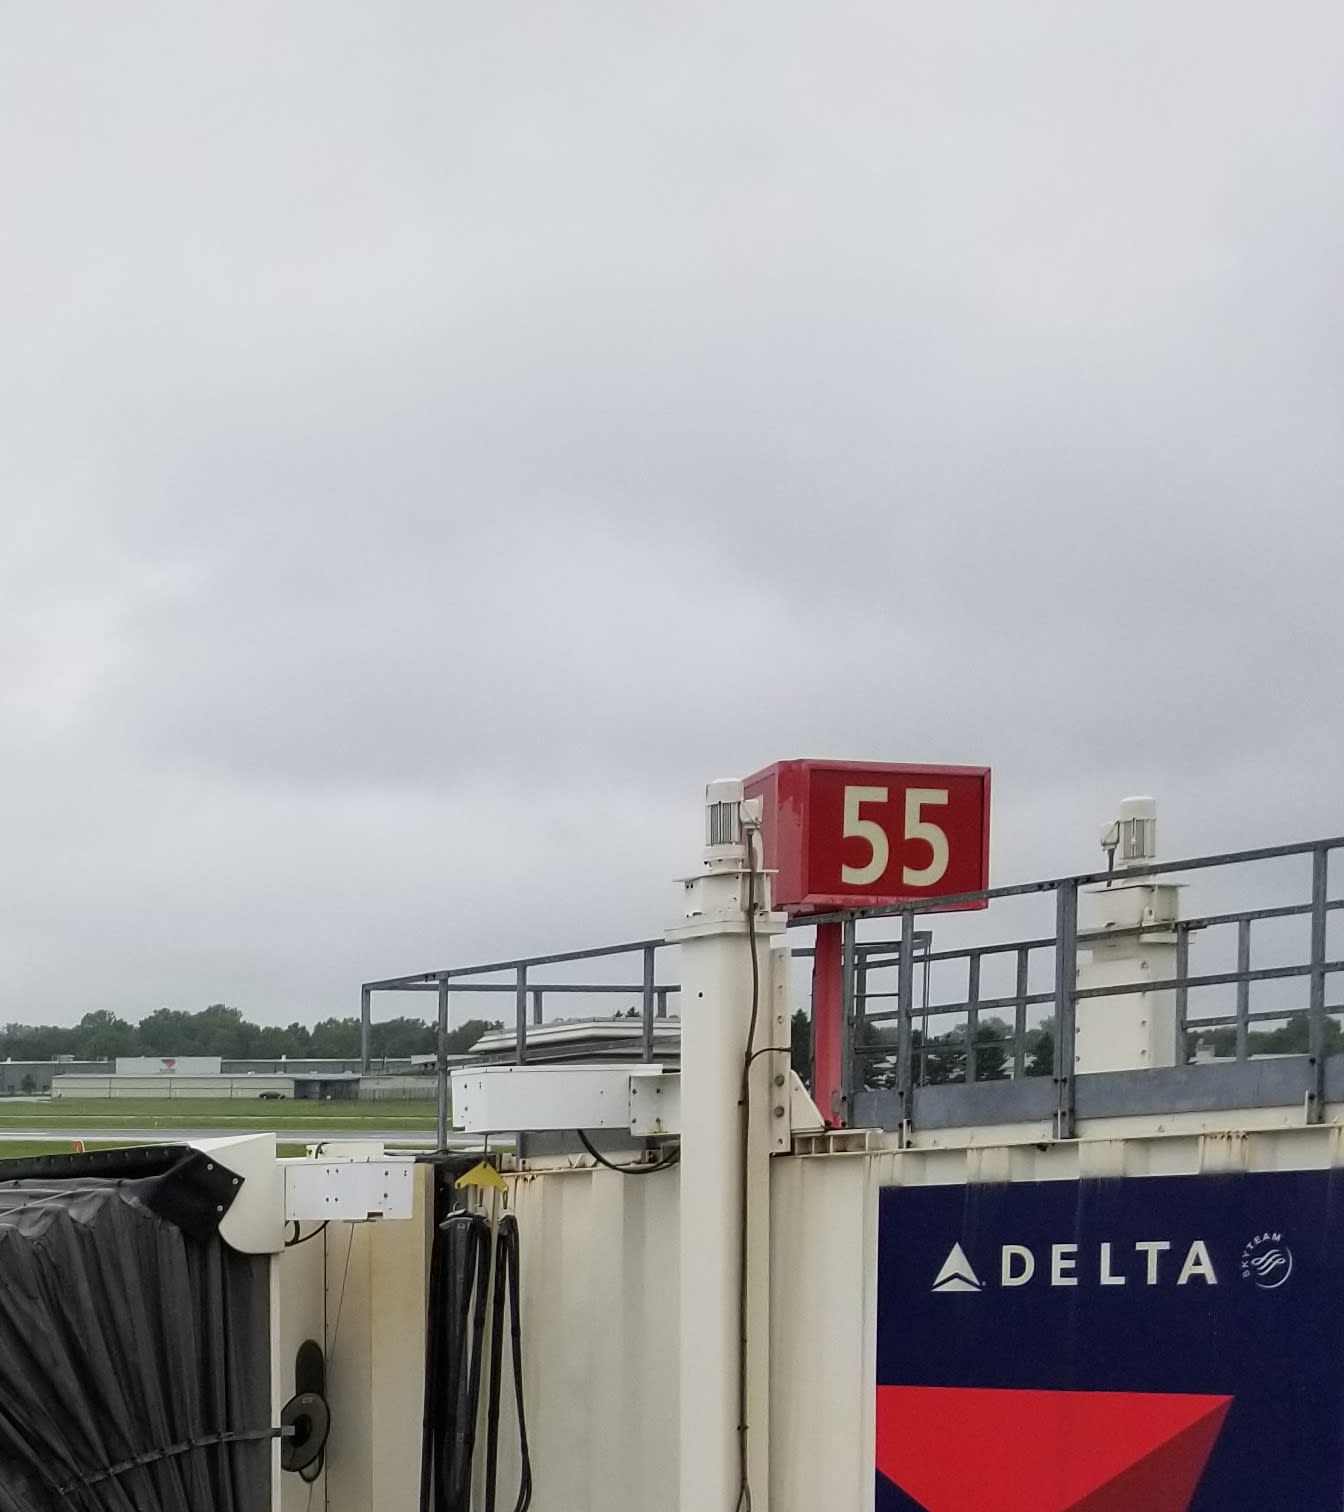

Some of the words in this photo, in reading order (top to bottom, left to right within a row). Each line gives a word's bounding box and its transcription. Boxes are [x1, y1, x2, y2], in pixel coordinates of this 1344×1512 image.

[841, 785, 950, 887] 55
[1000, 1240, 1218, 1287] DELTA
[1241, 1232, 1282, 1278] SKYTEAM
